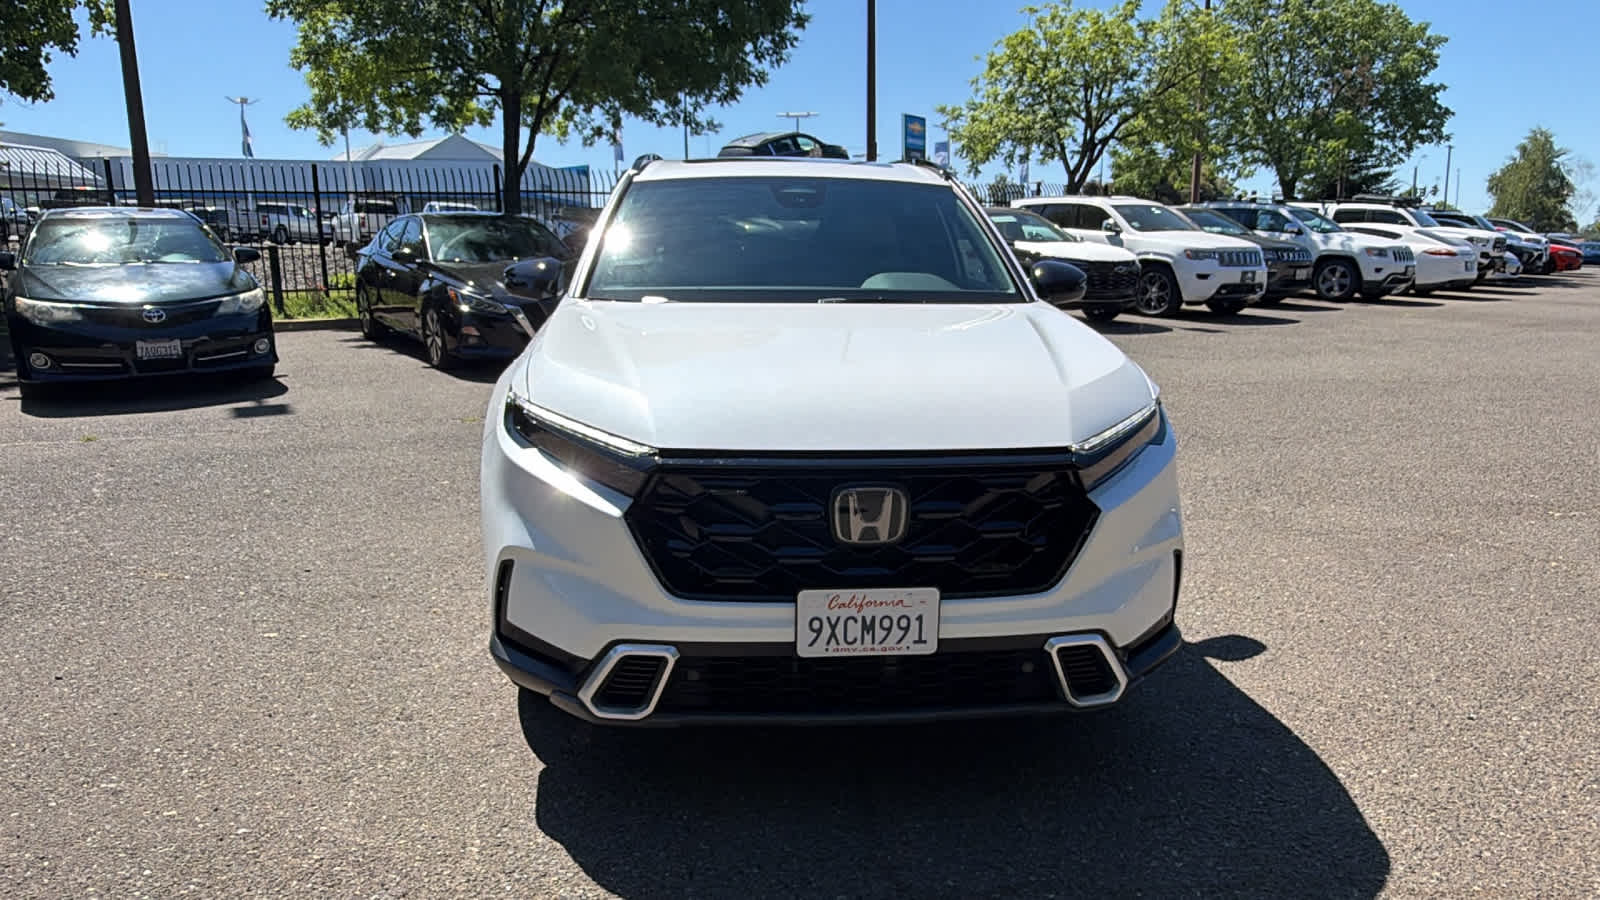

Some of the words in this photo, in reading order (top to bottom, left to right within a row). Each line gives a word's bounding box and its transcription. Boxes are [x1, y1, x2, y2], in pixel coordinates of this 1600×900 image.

[828, 594, 912, 613] California
[808, 614, 927, 647] 9XCM991
[832, 645, 904, 653] dmv.ca.gov
